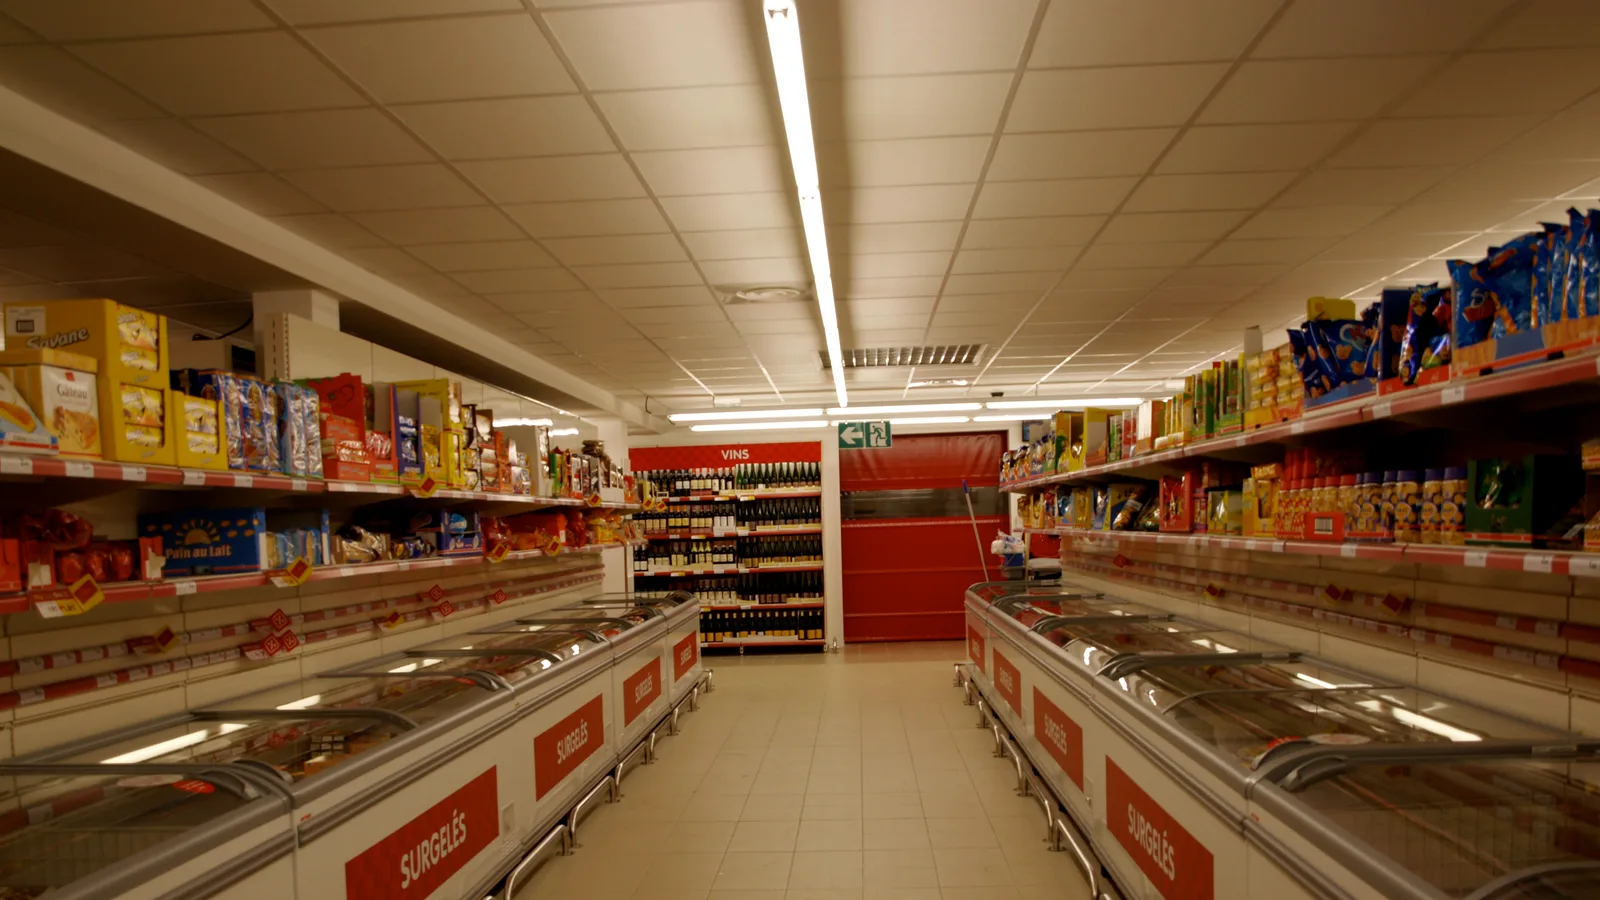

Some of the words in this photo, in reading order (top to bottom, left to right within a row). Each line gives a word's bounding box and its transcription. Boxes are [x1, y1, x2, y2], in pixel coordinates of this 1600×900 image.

[26, 326, 89, 349] Savane
[721, 449, 750, 460] VINS
[557, 720, 588, 765] SURGELÉS
[401, 808, 467, 889] SURGELÉS
[1127, 803, 1175, 881] SURGELÉS
